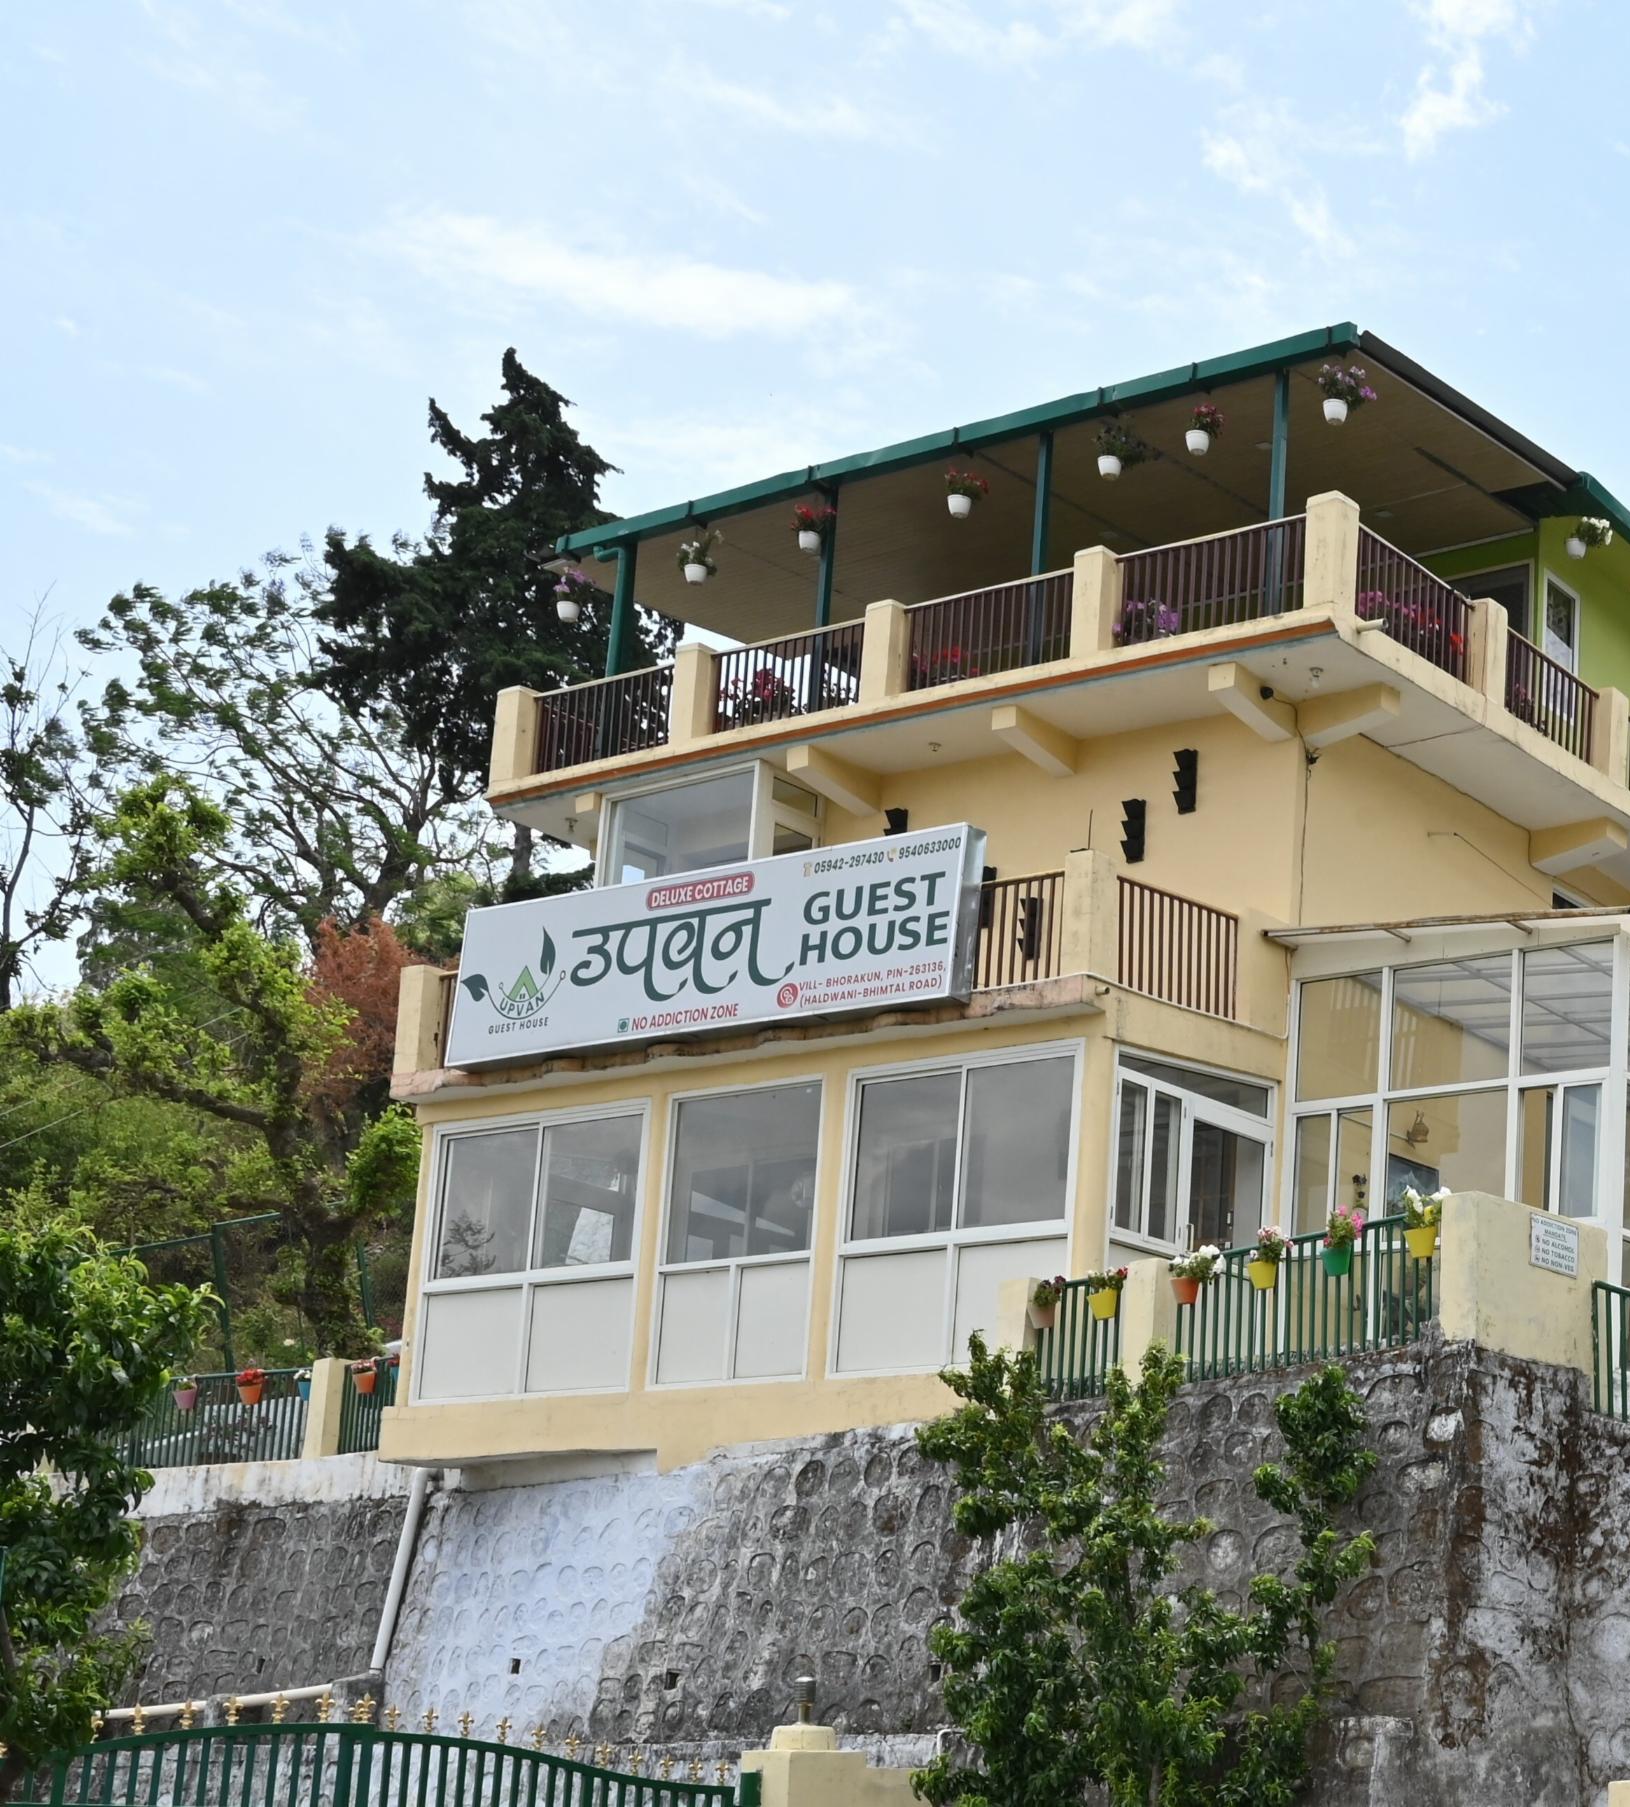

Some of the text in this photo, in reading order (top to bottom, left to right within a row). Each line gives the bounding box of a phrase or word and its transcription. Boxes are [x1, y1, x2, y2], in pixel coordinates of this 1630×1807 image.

[898, 837, 962, 860] 9540633000
[814, 851, 885, 874] 05942-297430
[651, 876, 749, 908] DELUXE COTTAGE
[803, 871, 946, 925] GUEST
[570, 898, 795, 1002] उपवन
[799, 911, 950, 967] HOUSE
[800, 974, 943, 1009] (HALDWANI-BHIMTAL ROAD)
[499, 992, 545, 1017] UPVAN
[631, 1003, 739, 1031] NO ADDICTION ZONE
[488, 1016, 549, 1035] GUEST HOUSE
[1541, 1238, 1550, 1246] NO
[1541, 1247, 1575, 1263] NO TOBACCO
[1541, 1256, 1550, 1265] NO
